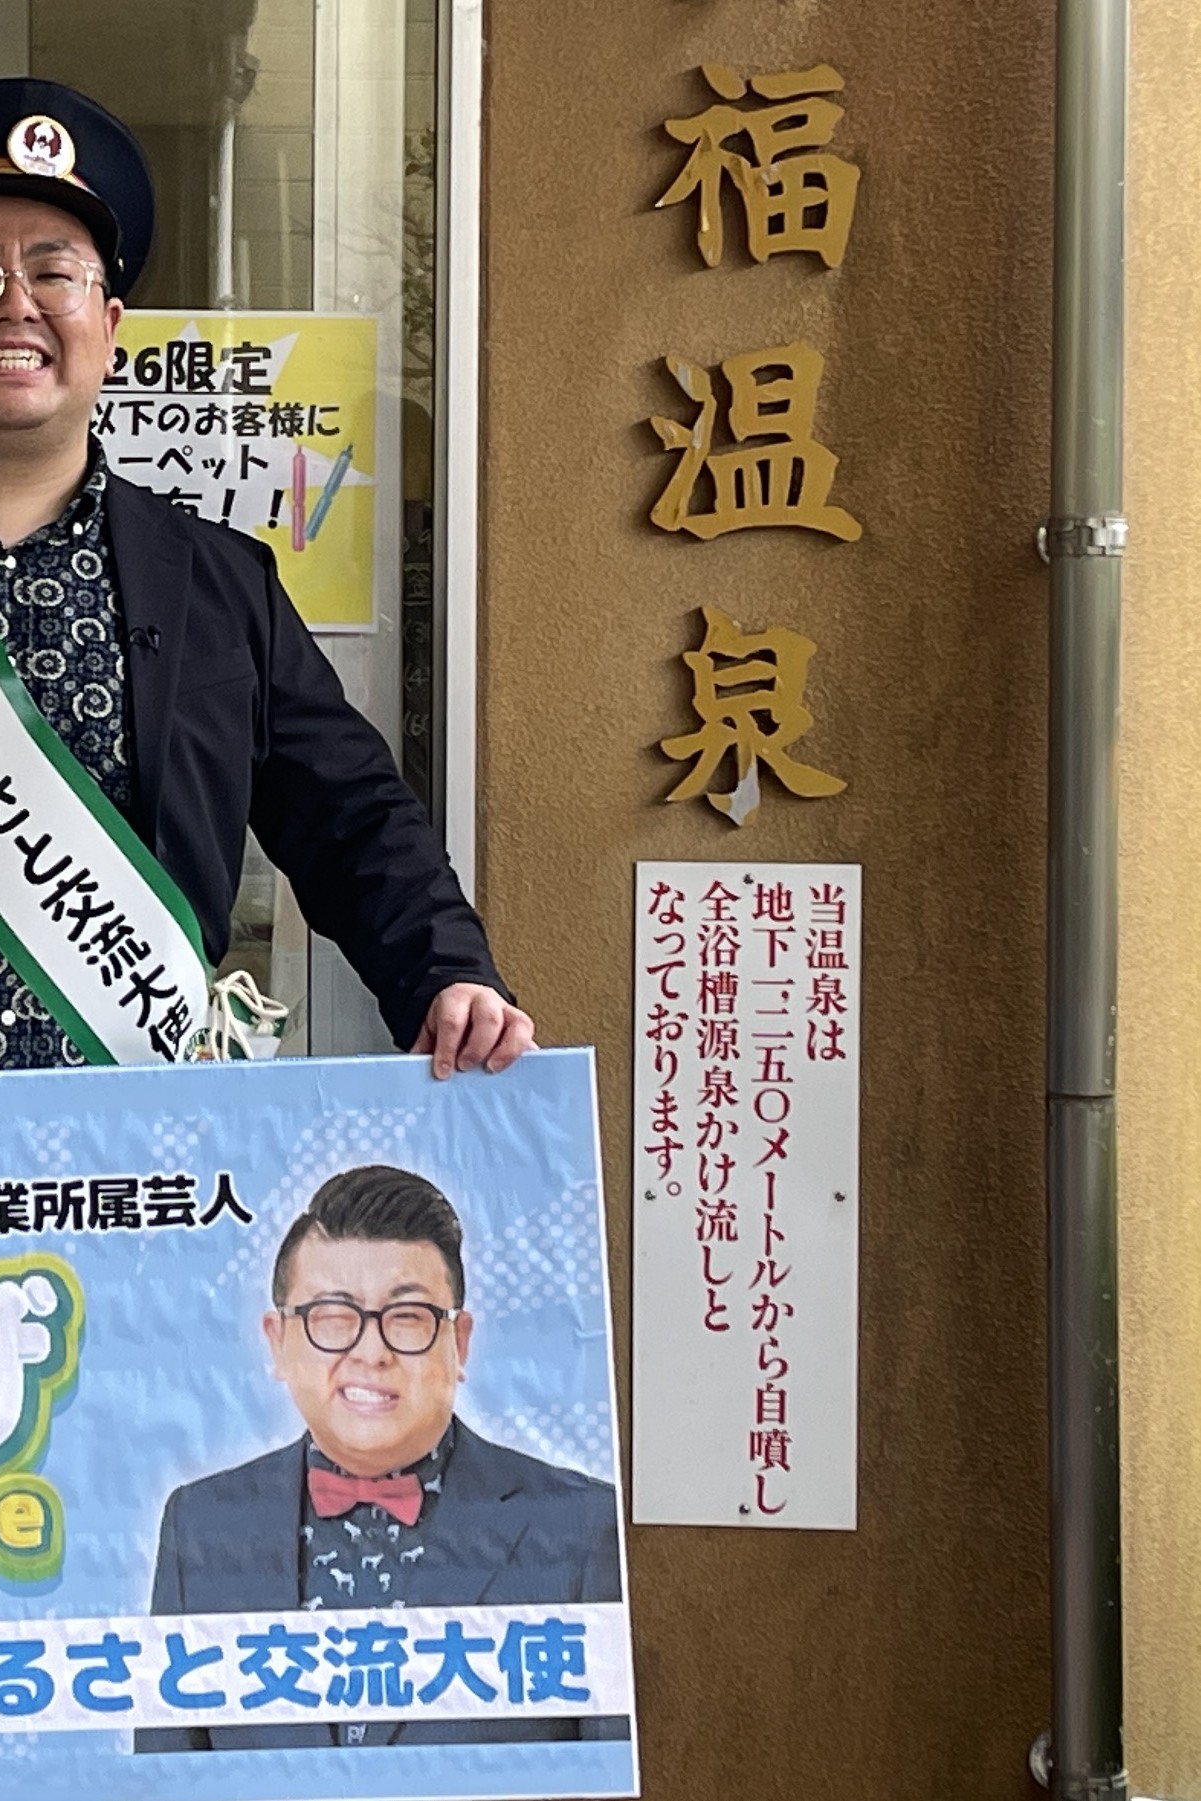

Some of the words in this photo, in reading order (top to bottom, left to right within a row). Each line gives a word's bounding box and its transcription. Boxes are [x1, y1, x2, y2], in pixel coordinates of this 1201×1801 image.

[651, 63, 863, 828] 福温泉
[644, 881, 688, 1196] なっております。
[695, 880, 741, 1332] 全浴槽源泉かけ流しと
[805, 882, 848, 1061] 当温泉は
